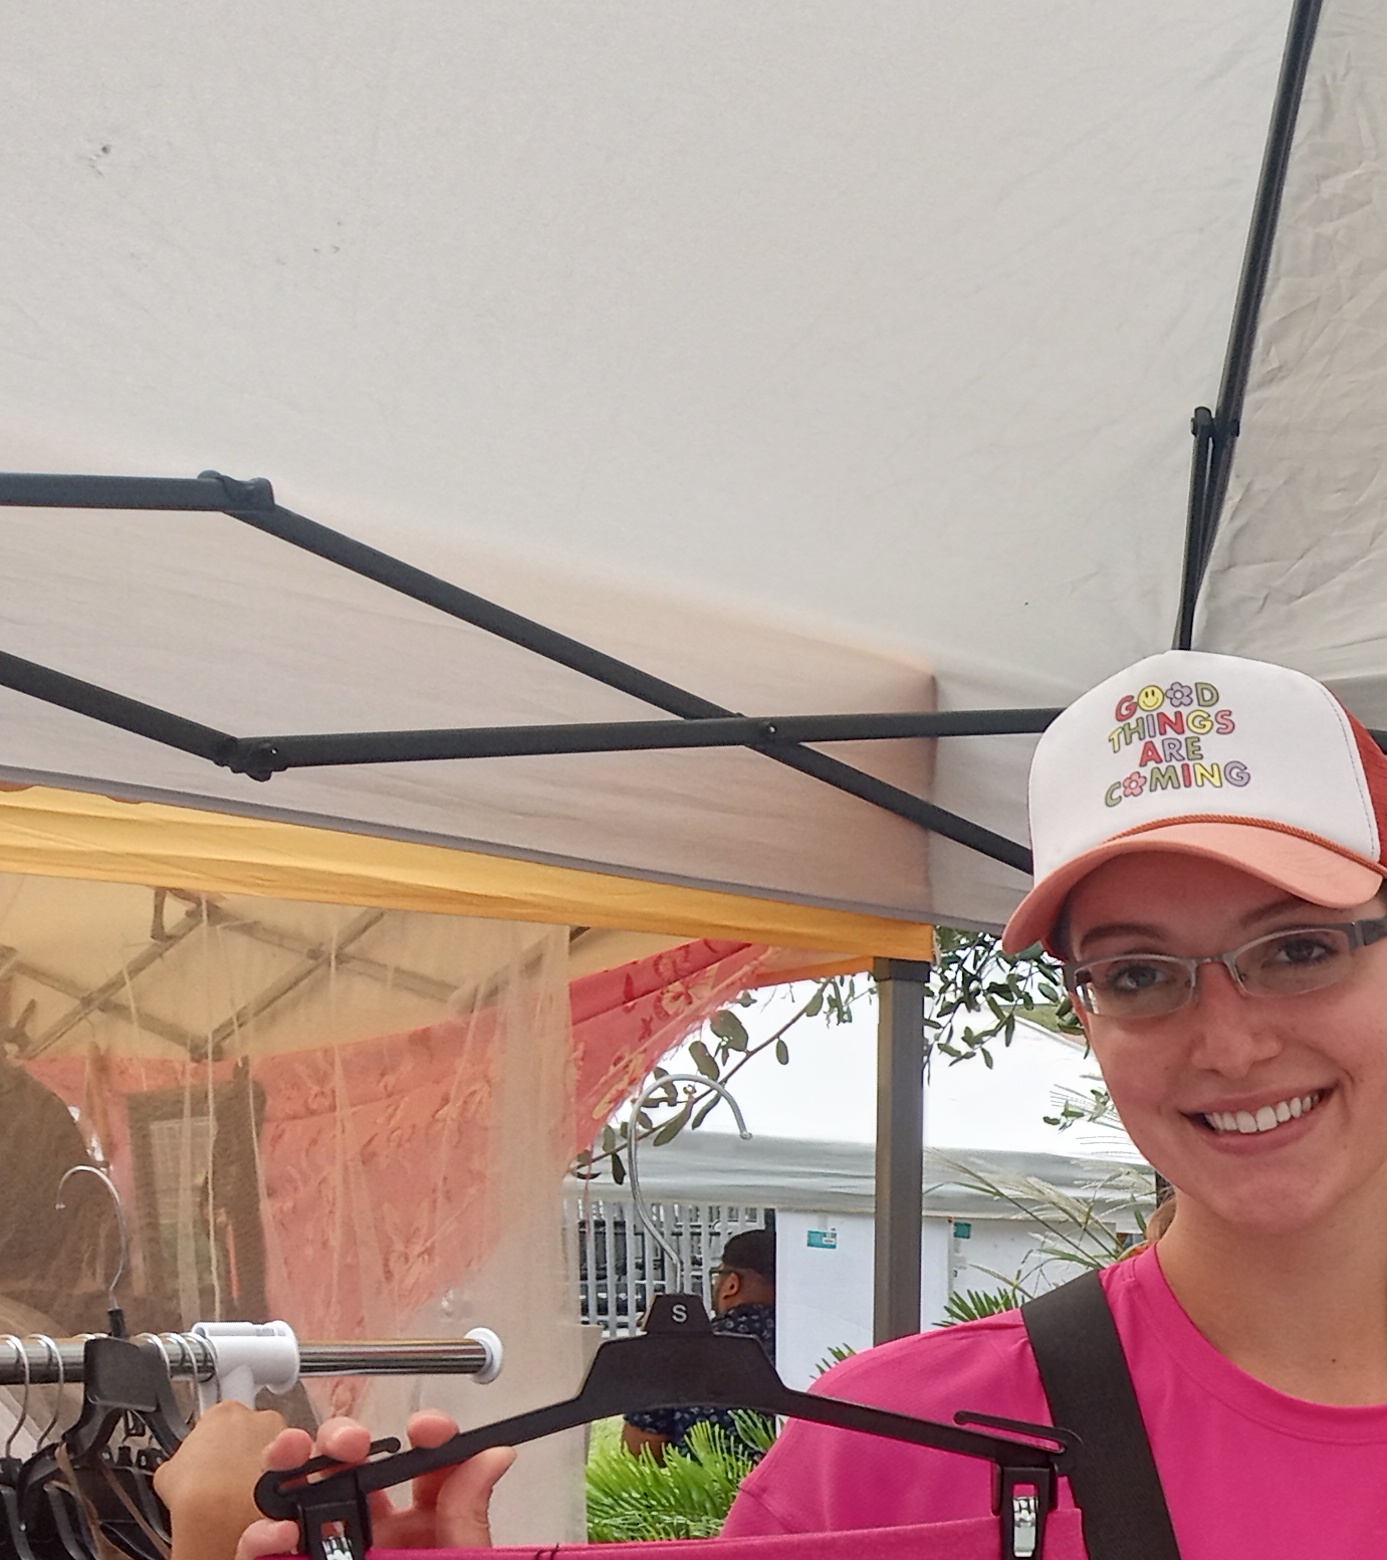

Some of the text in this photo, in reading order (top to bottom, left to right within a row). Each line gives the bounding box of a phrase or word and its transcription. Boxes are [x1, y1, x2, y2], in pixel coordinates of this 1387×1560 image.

[1115, 681, 1219, 721] GOOD
[1108, 709, 1236, 753] THINGS
[1138, 736, 1204, 766] ARE
[1104, 760, 1250, 808] COMING
[671, 1304, 688, 1323] S
